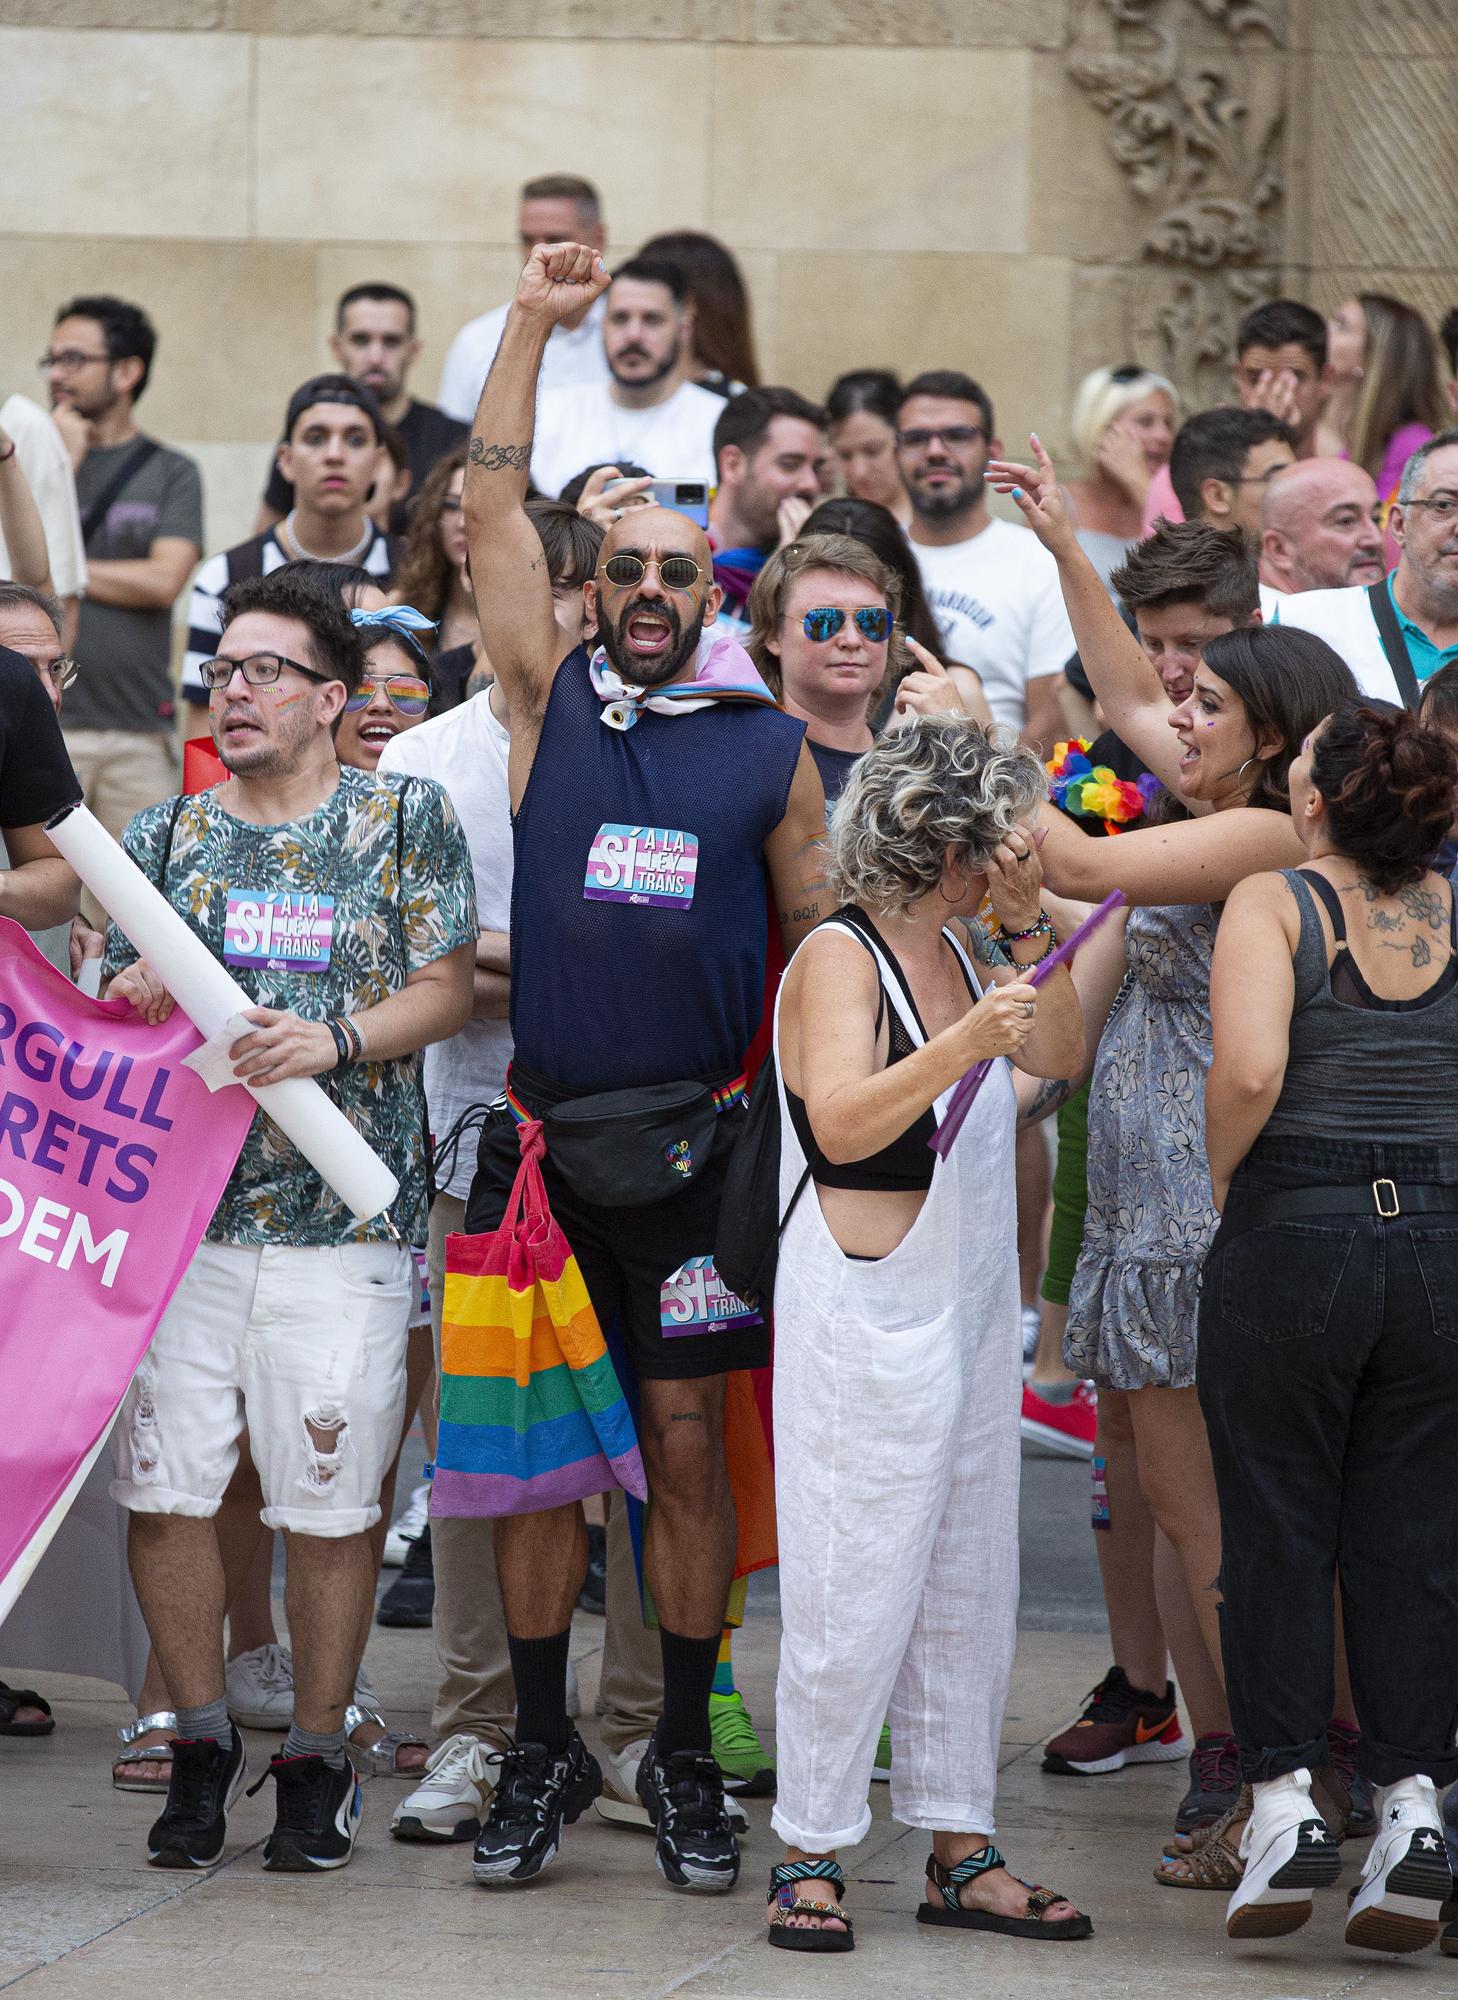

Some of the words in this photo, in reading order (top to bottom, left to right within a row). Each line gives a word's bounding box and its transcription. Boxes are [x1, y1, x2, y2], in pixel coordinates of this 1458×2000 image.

[644, 829, 656, 850] A
[663, 831, 685, 853] LA
[596, 827, 643, 889] SÍ
[646, 850, 681, 874] LEY
[638, 871, 685, 894] TRANS
[281, 894, 292, 916] A
[299, 895, 319, 918] LA
[233, 892, 279, 955] SÍ
[282, 915, 316, 938] LEY
[275, 936, 321, 957] TRANS
[669, 1258, 709, 1322] SÍ
